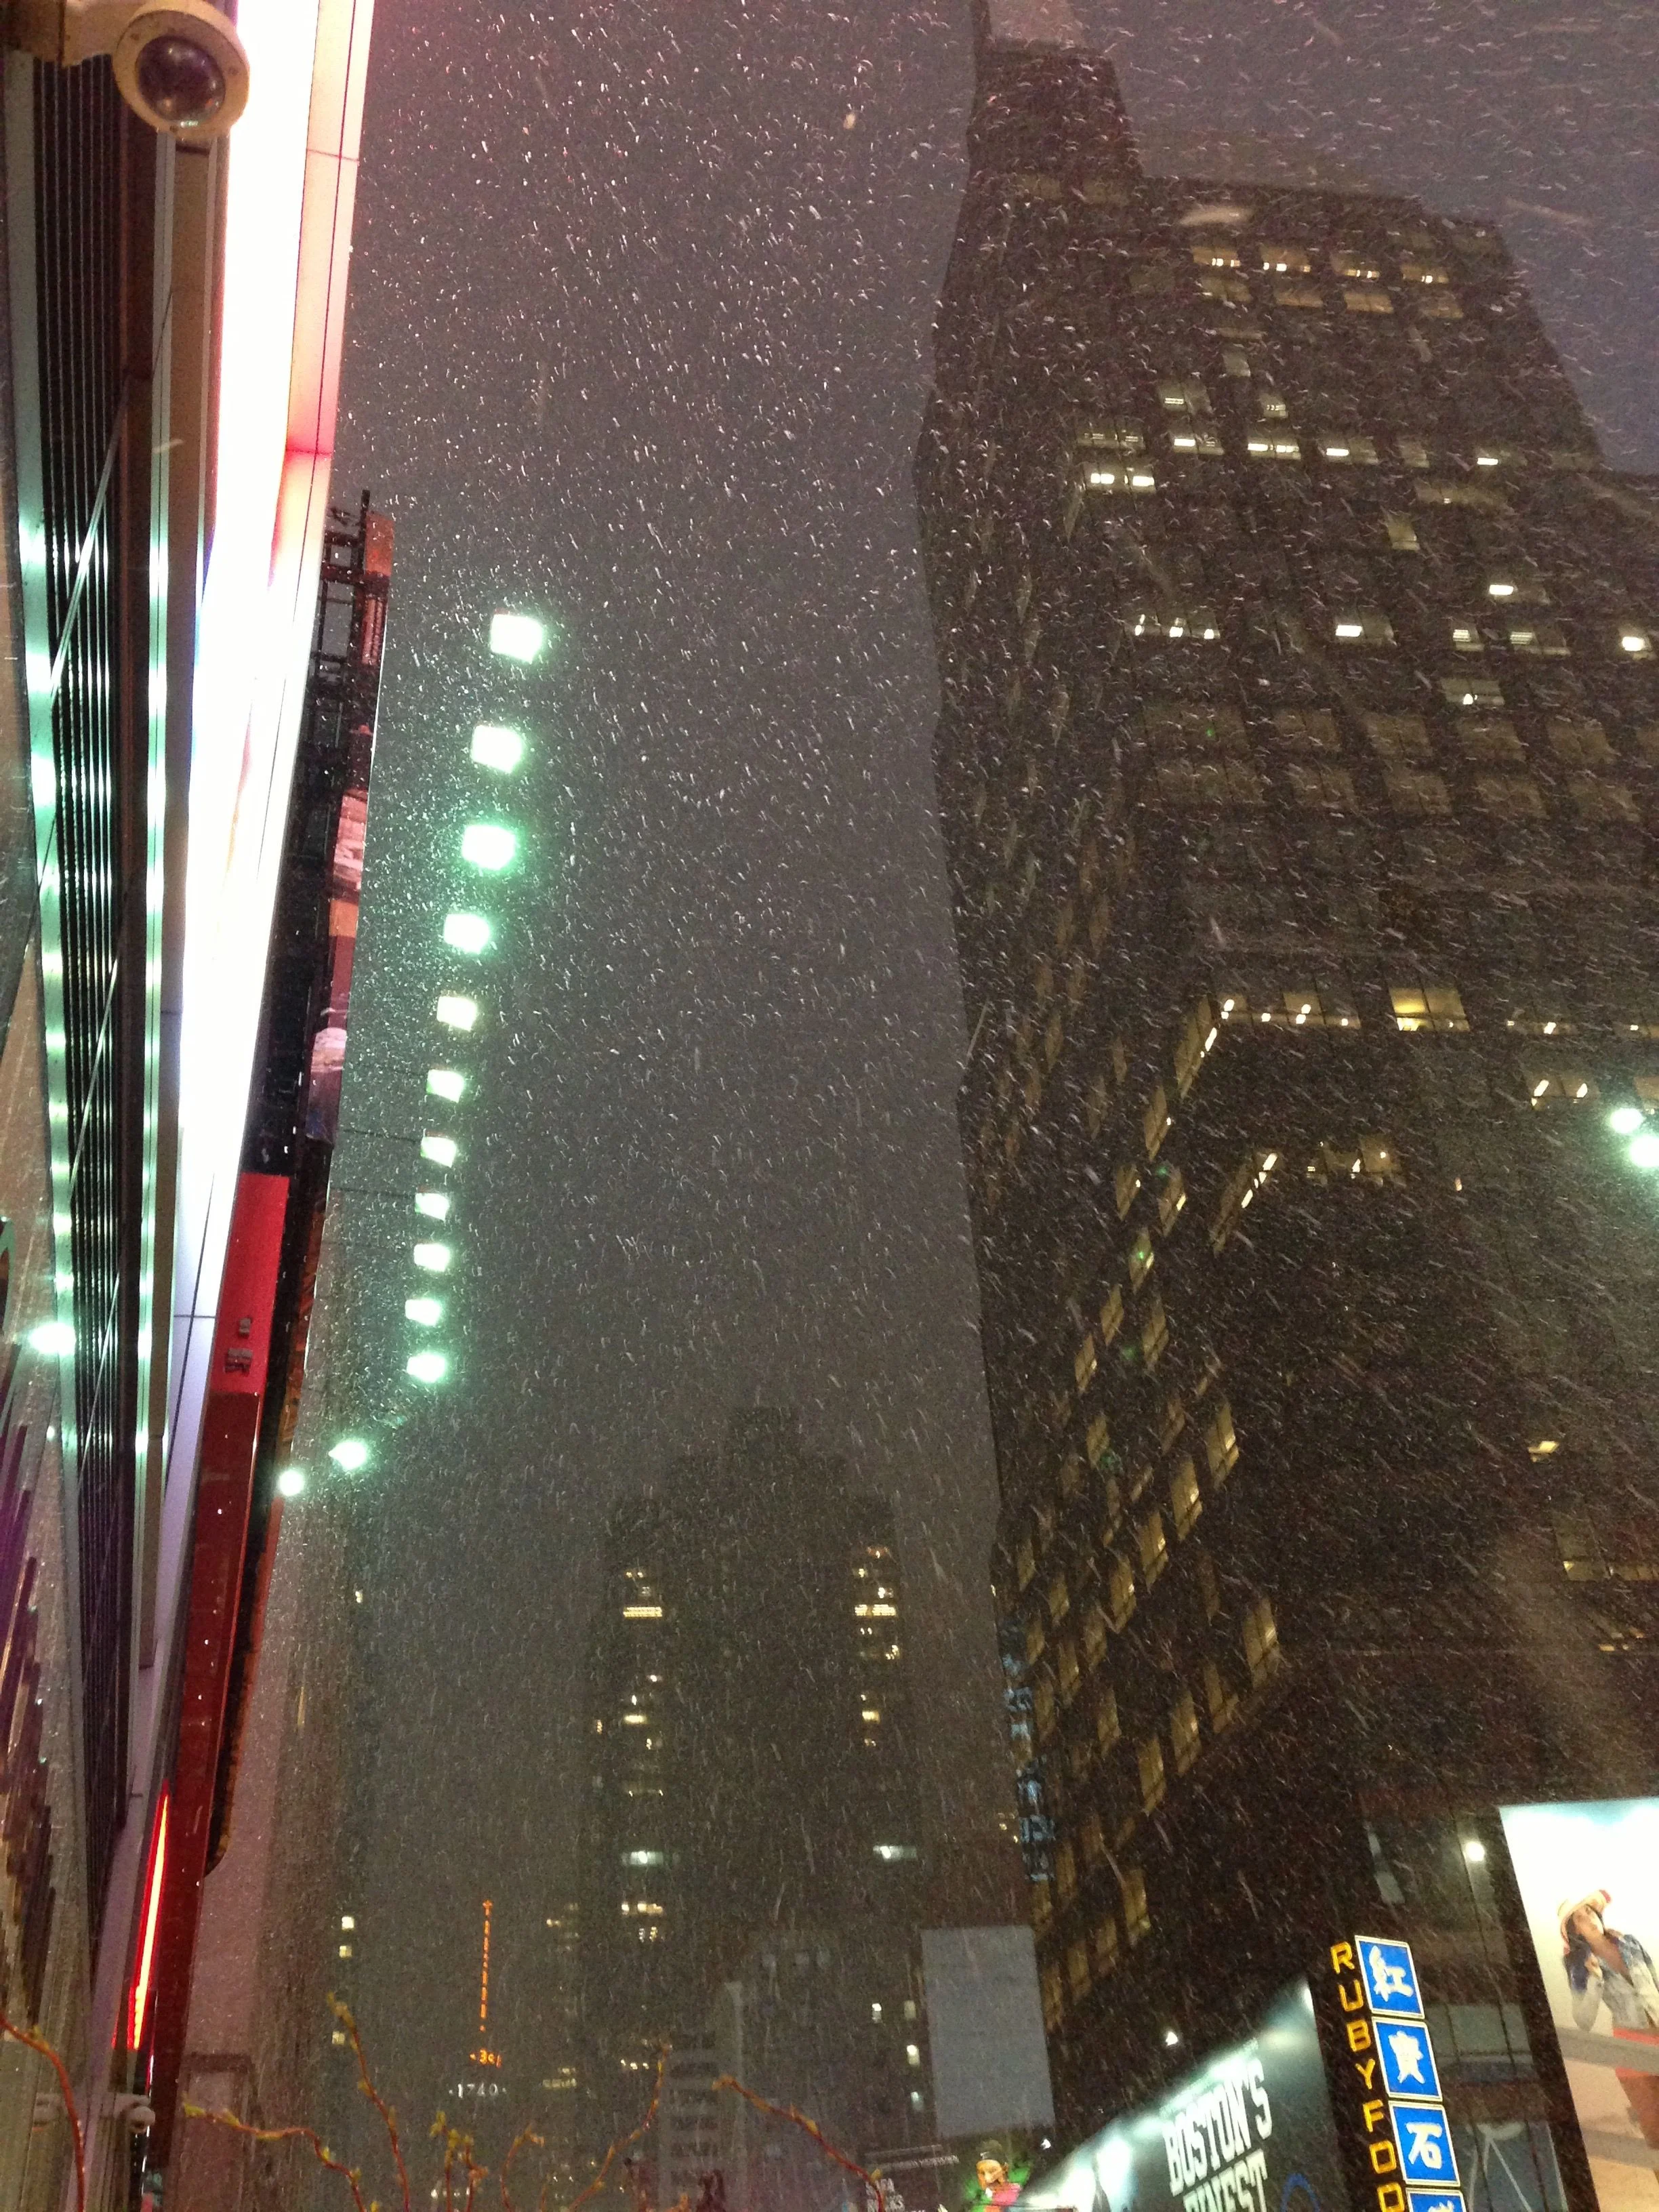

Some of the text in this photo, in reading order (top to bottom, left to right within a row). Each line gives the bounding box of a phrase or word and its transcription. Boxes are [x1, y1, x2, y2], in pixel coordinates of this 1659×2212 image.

[1330, 1941, 1376, 2089] RUBY
[1368, 1945, 1455, 2212] 紅寶石
[1162, 2057, 1273, 2197] BOSTON'S
[1183, 2148, 1268, 2212] EST
